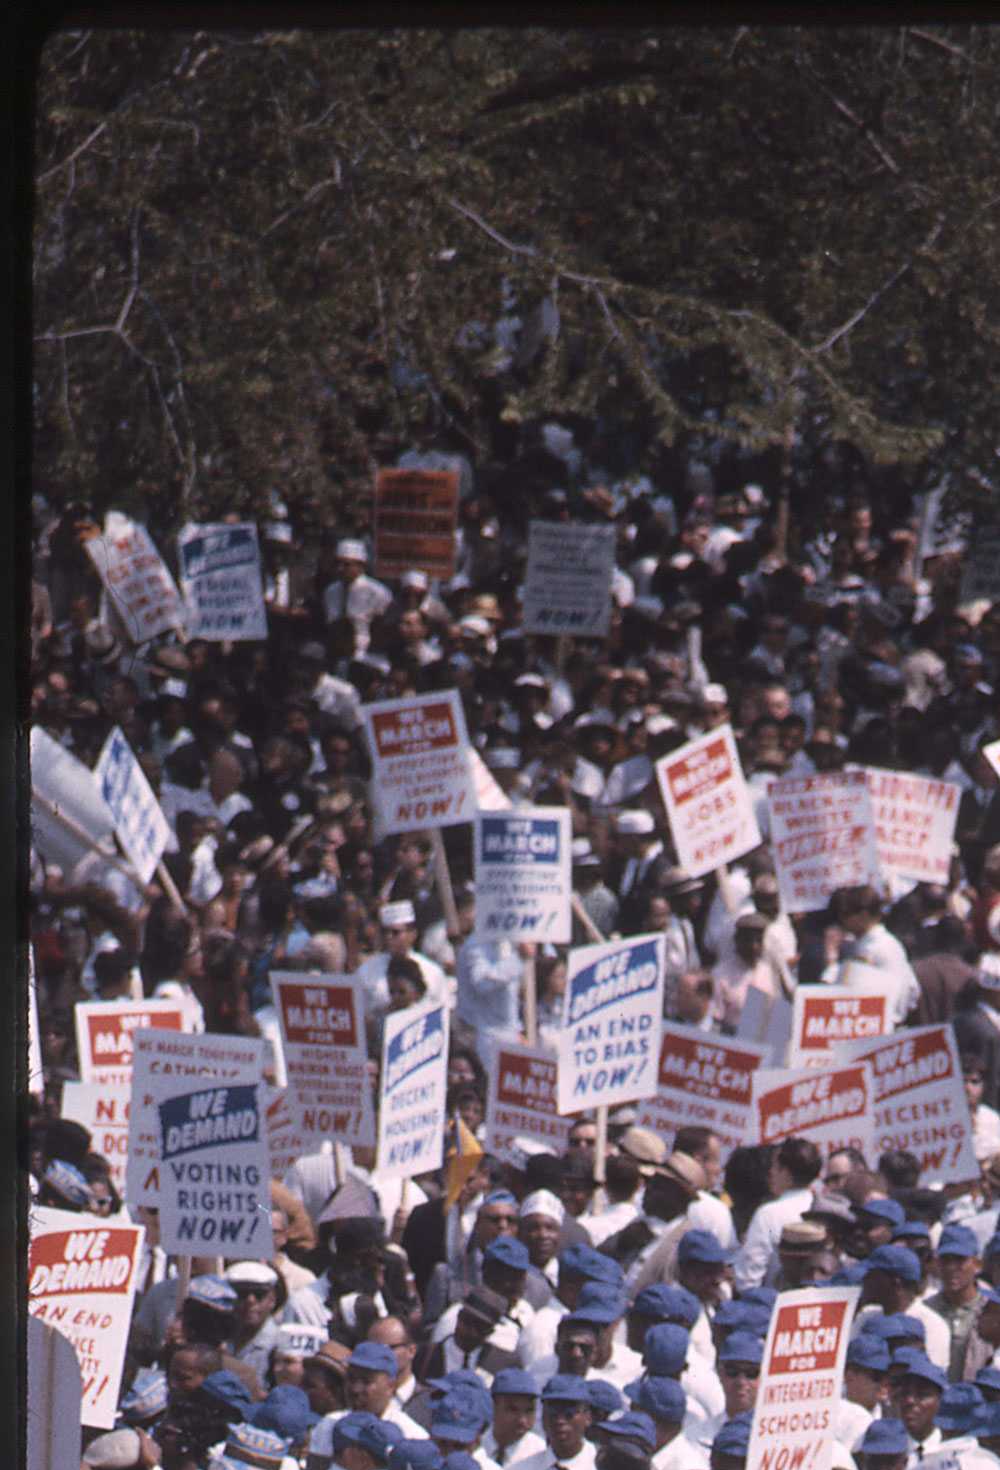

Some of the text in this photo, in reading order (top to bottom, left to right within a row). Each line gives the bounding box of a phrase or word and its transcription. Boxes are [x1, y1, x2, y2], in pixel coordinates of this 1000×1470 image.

[397, 789, 465, 821] NOW!
[687, 791, 736, 829] JOBS
[485, 911, 558, 932] NOW!
[287, 1007, 351, 1030] MARCH
[664, 1053, 749, 1090] MARCH
[189, 1089, 228, 1118] WE
[765, 1088, 864, 1138] DEMAND
[166, 1109, 256, 1152] DEMAND
[304, 1111, 362, 1136] NOW!
[171, 1163, 260, 1185] VOTING
[178, 1190, 257, 1213] RIGHTS
[177, 1217, 259, 1243] NOW!
[64, 1231, 110, 1260] WE
[29, 1256, 130, 1295] DEMAND
[33, 1304, 112, 1328] AN END
[797, 1307, 822, 1328] WE
[774, 1327, 838, 1358] MARCH
[763, 1380, 834, 1404] INTEGRATED
[758, 1410, 830, 1437] SCHOOLS
